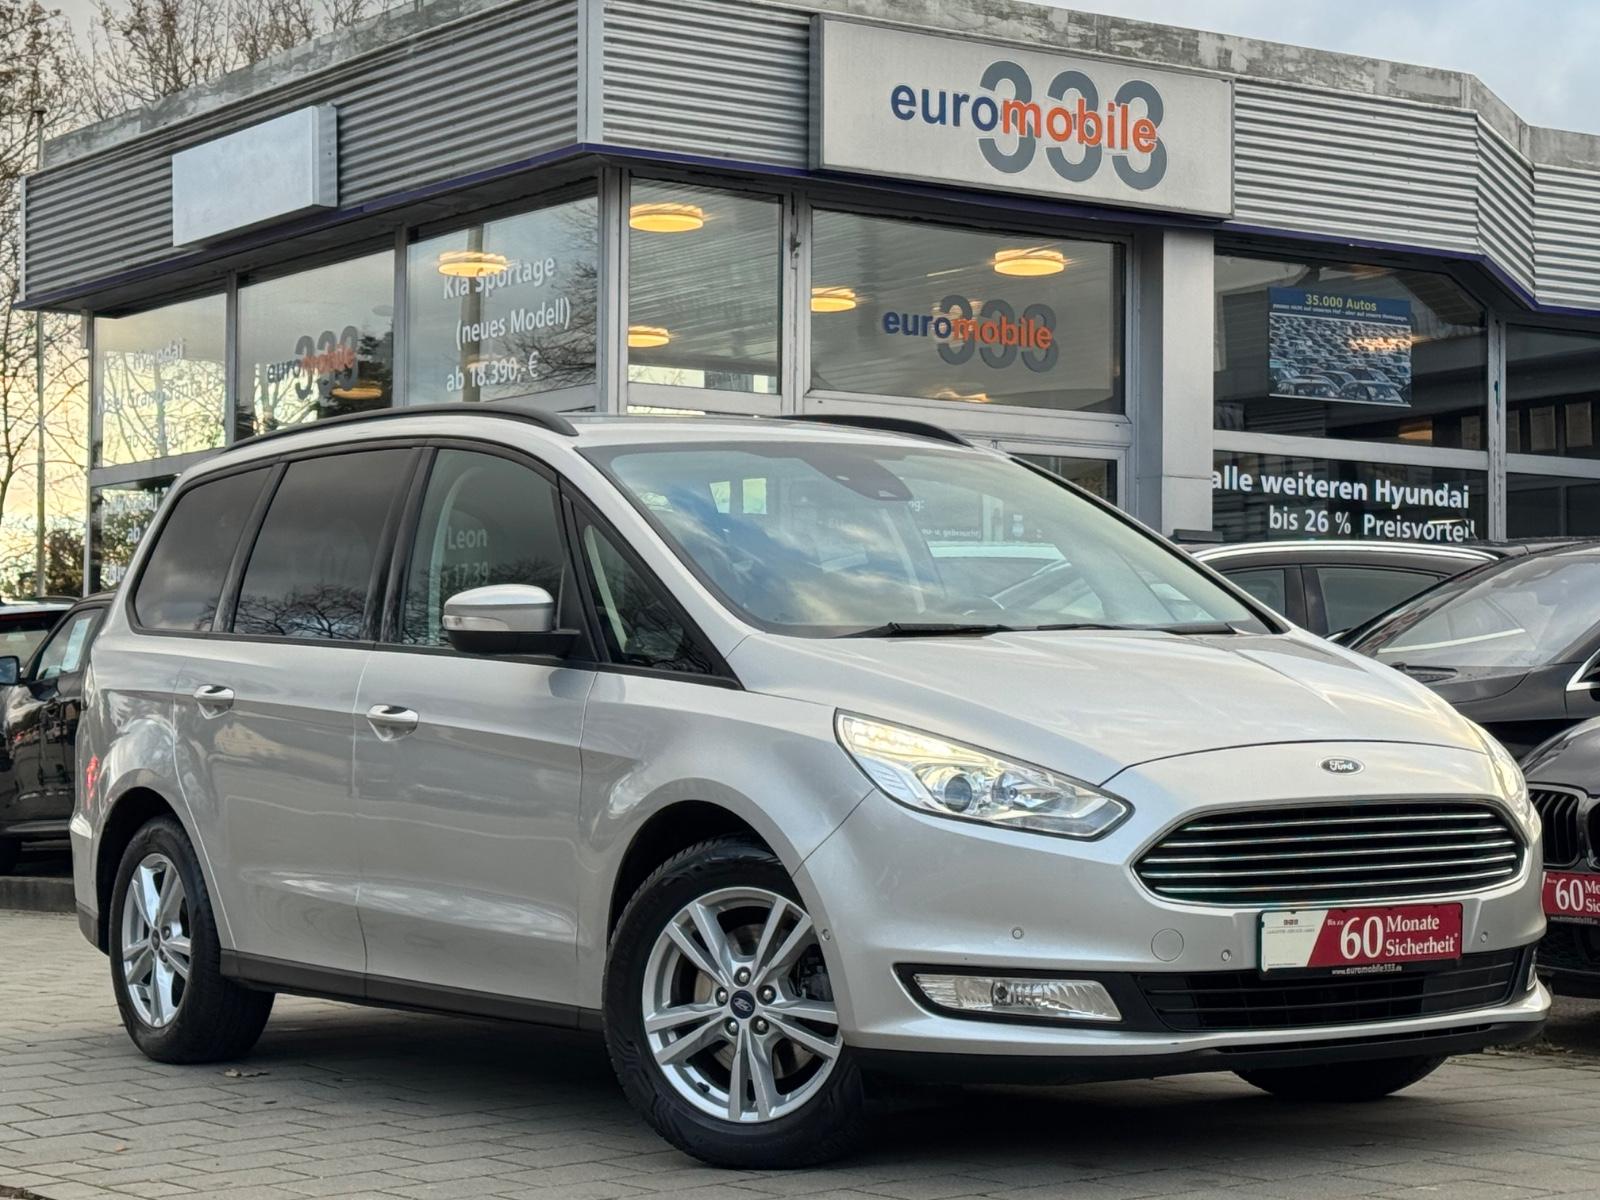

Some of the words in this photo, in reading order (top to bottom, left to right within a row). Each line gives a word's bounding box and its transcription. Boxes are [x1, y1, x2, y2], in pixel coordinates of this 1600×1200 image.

[890, 84, 1156, 154] euromobile
[977, 60, 1168, 190] 333
[475, 257, 555, 297] Sportage
[1304, 294, 1343, 308] 35.000
[1346, 298, 1377, 312] Autos
[456, 319, 506, 351] (neues
[510, 296, 571, 334] Modell)
[881, 311, 1053, 349] euromobile
[937, 295, 1060, 373] 333
[446, 364, 465, 392] ab
[1212, 465, 1253, 491] alle
[1260, 472, 1368, 500] weiteren
[1375, 480, 1469, 510] Hyundai
[447, 526, 488, 550] Leon
[1269, 504, 1298, 530] bis
[1304, 509, 1329, 533] 26
[1335, 512, 1351, 534] %
[1363, 513, 1475, 542] Preisvorteil
[1555, 878, 1584, 911] 60
[1340, 916, 1383, 960] 60
[1386, 915, 1440, 933] Monate
